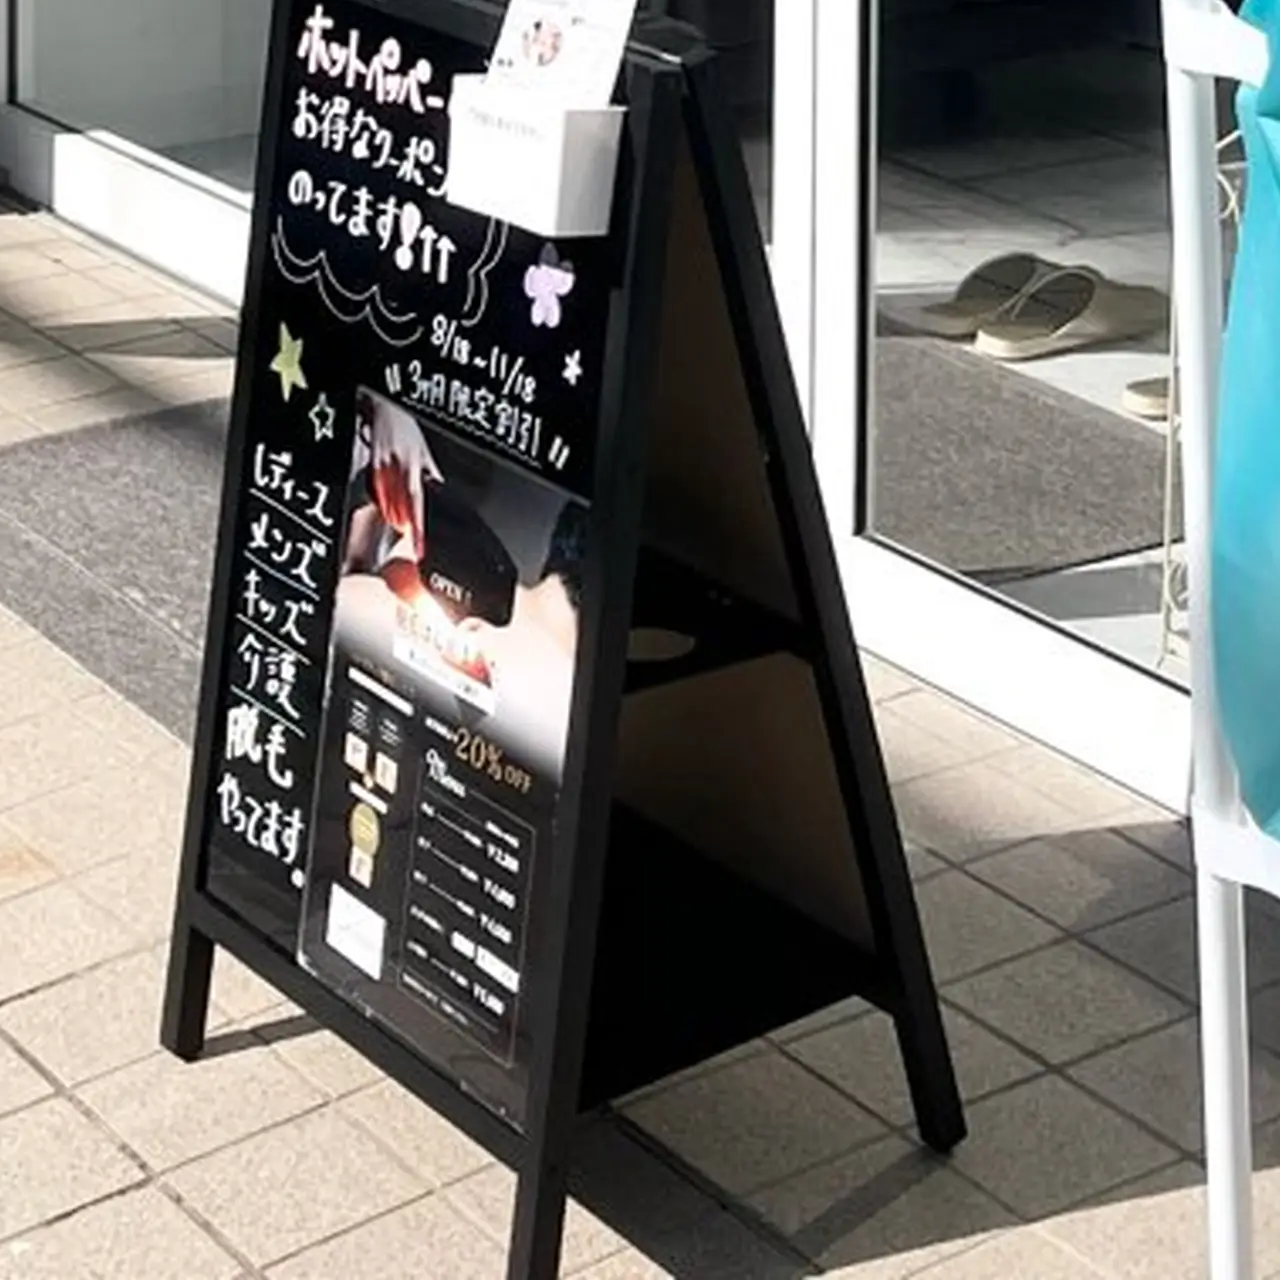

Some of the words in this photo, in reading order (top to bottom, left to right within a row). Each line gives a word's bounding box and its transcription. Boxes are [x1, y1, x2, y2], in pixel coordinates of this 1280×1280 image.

[296, 3, 445, 114] ホットペッパー
[291, 86, 450, 198] お得なクーポン
[253, 442, 334, 528] レディース
[248, 512, 329, 589] メンズ
[243, 568, 315, 646] キッズ
[236, 632, 301, 721] 介護
[225, 702, 294, 790] 脱毛
